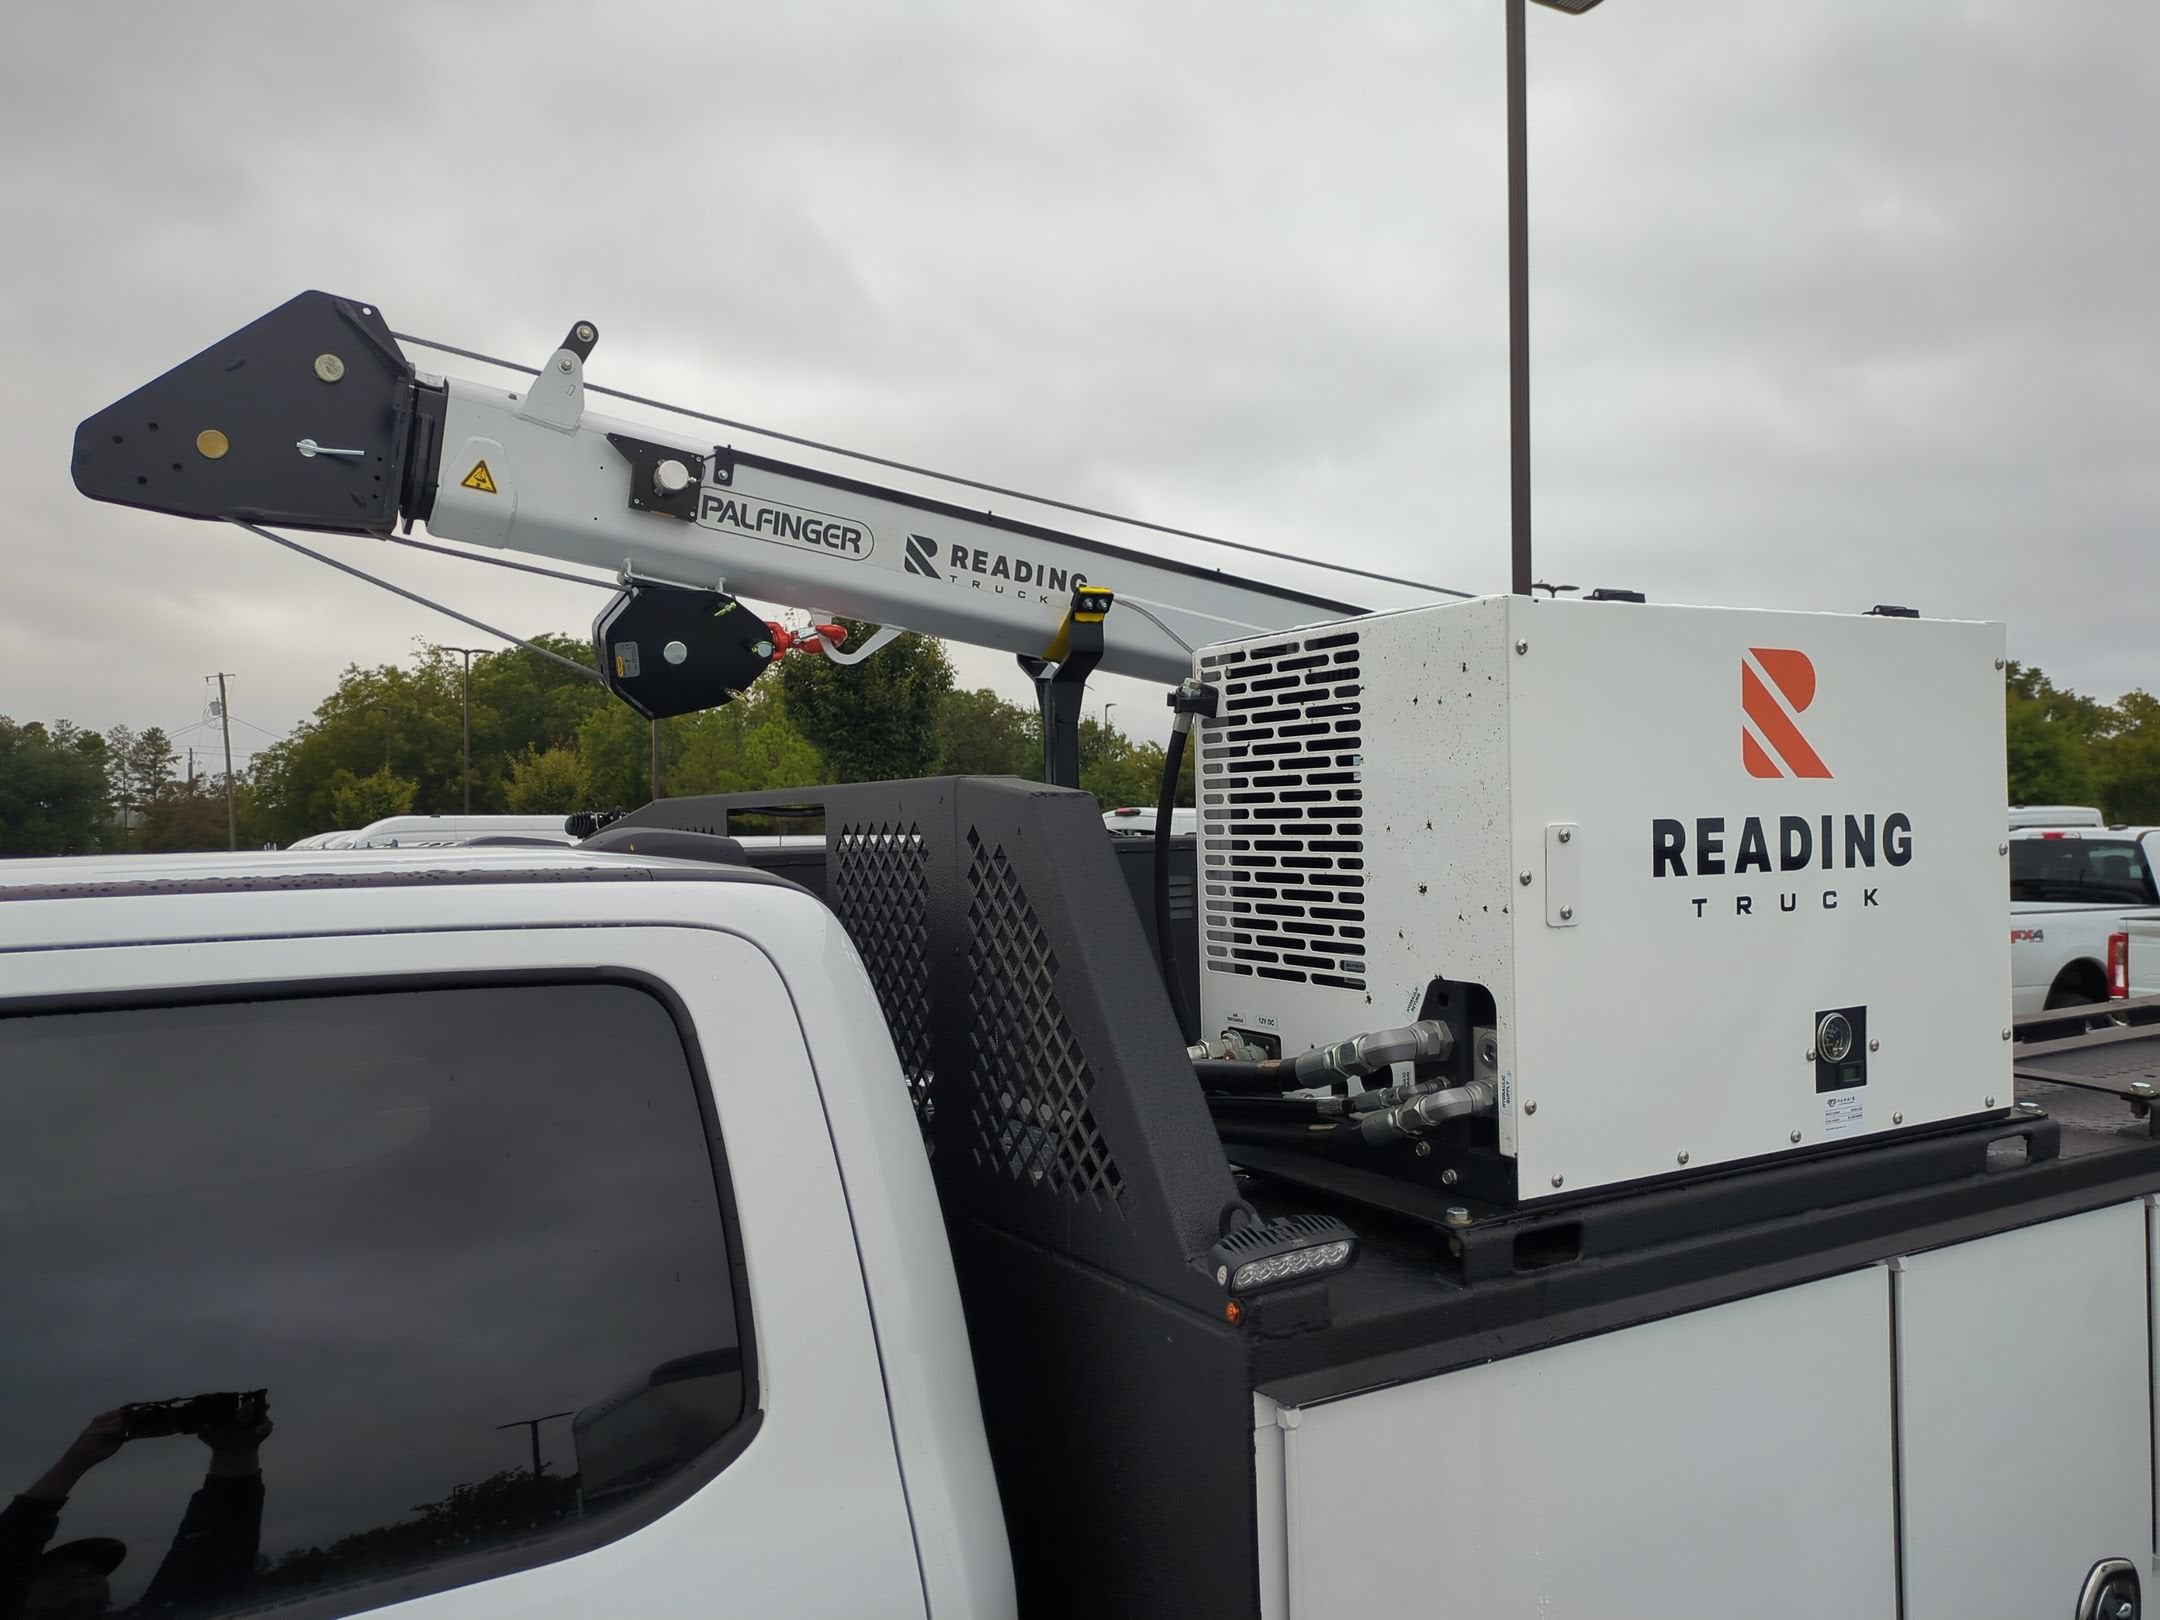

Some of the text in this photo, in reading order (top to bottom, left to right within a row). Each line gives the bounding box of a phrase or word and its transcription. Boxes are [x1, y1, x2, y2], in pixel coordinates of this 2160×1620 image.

[700, 494, 862, 554] PALFINGER
[949, 574, 1049, 605] TRUCK
[1652, 812, 1912, 878] READING
[1691, 888, 1879, 918] TRUCK
[2010, 929, 2044, 944] FX4
[1267, 1018, 1275, 1026] DC
